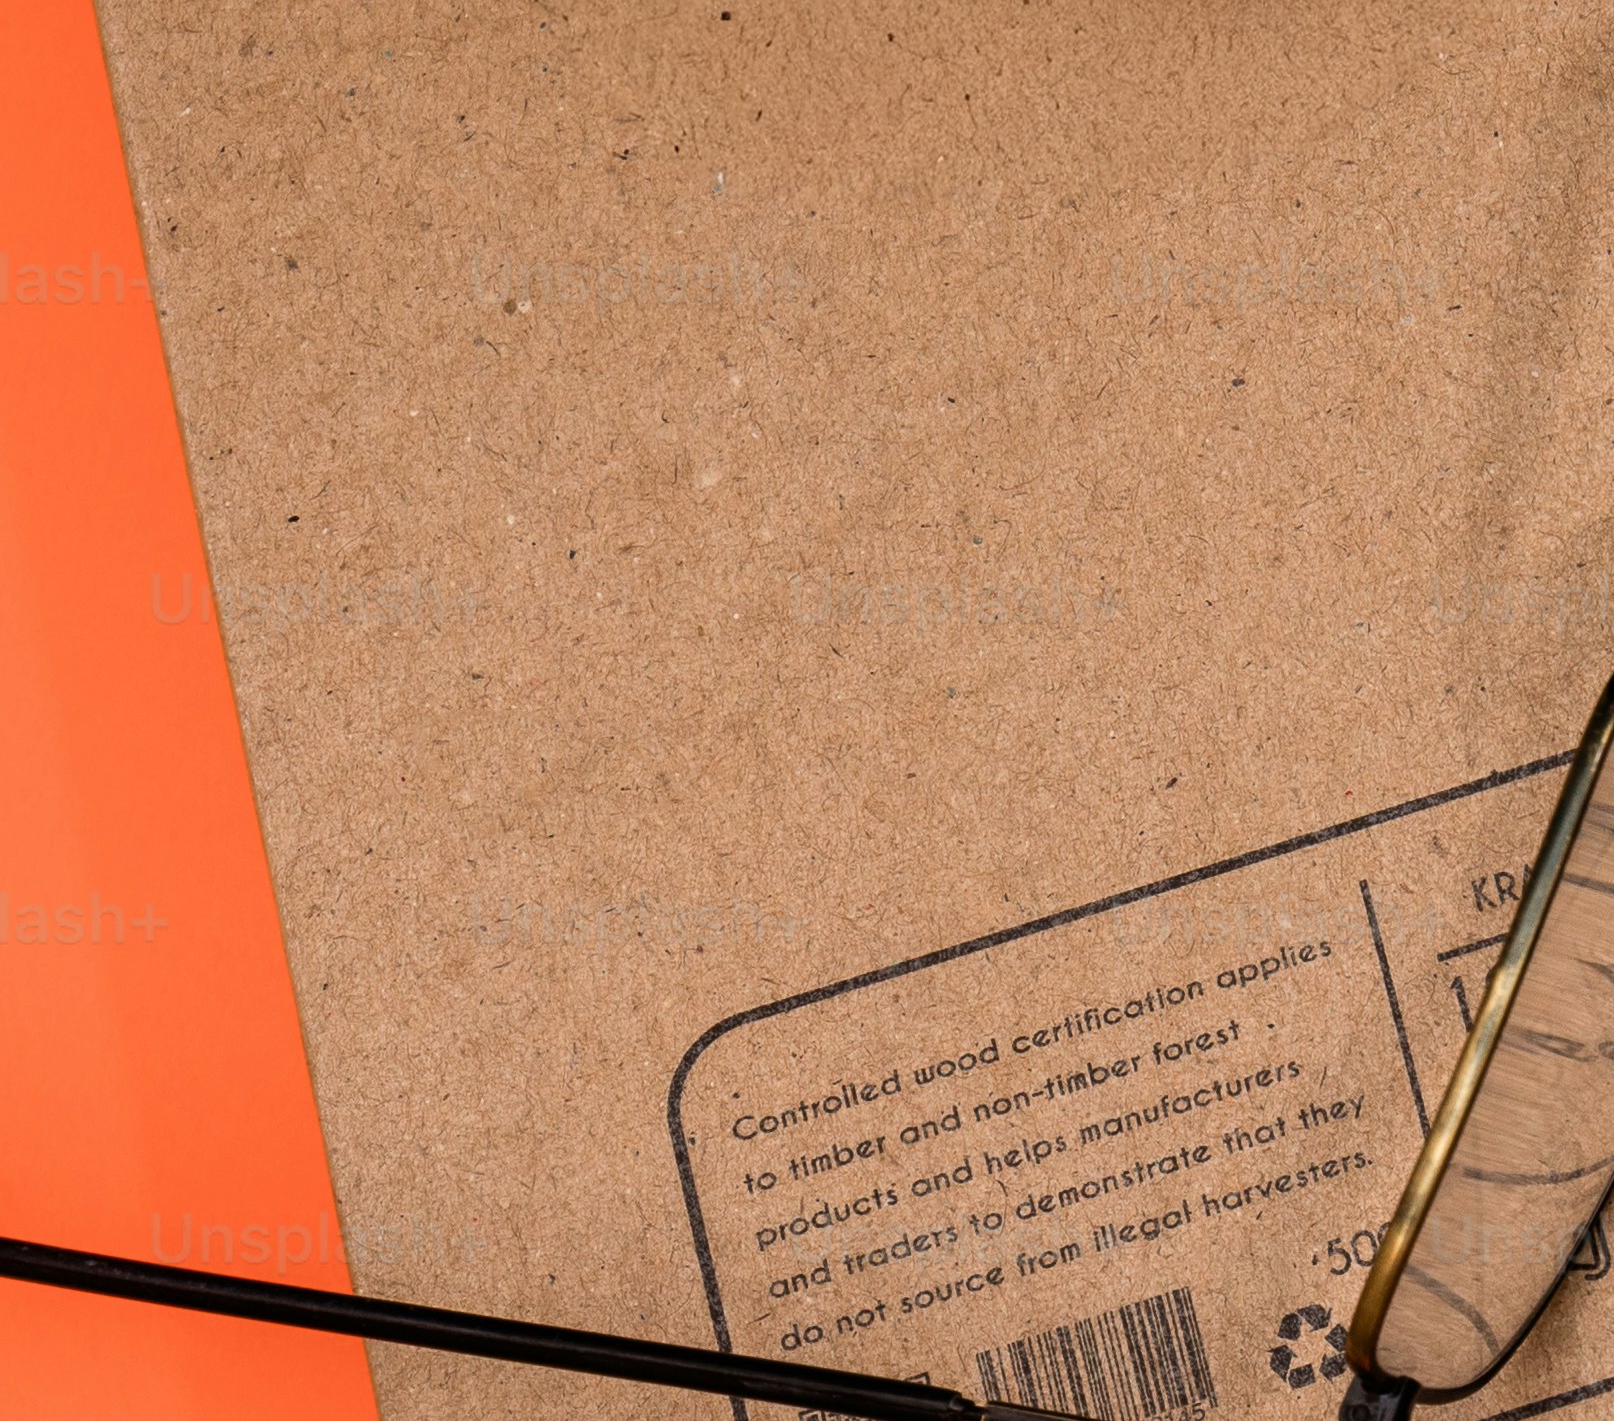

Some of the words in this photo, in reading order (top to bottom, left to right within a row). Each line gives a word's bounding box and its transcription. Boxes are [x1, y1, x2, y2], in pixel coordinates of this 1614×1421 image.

[731, 1069, 902, 1141] Controlled
[913, 1038, 1000, 1086] wood
[1011, 981, 1204, 1054] certification
[1217, 940, 1334, 989] applies
[743, 1165, 778, 1195] to
[789, 1136, 886, 1180] timber
[899, 1105, 962, 1145] and
[973, 1055, 1141, 1122] non-timber
[1152, 1019, 1239, 1065] forest
[755, 1188, 899, 1252] products
[911, 1157, 973, 1197] and
[983, 1135, 1067, 1175] helps
[1079, 1061, 1300, 1145] manufacturers
[769, 1258, 832, 1299] and
[843, 1226, 958, 1275] traders
[968, 1205, 1004, 1232] to
[1015, 1145, 1212, 1220] demonstrate
[1223, 1116, 1286, 1154] that
[1299, 1094, 1365, 1134] they
[780, 1318, 824, 1352] do
[836, 1300, 886, 1334] not
[901, 1266, 1005, 1314] source
[1017, 1242, 1081, 1277] from
[1093, 1199, 1192, 1252] illegal
[1202, 1152, 1374, 1217] harvesters.
